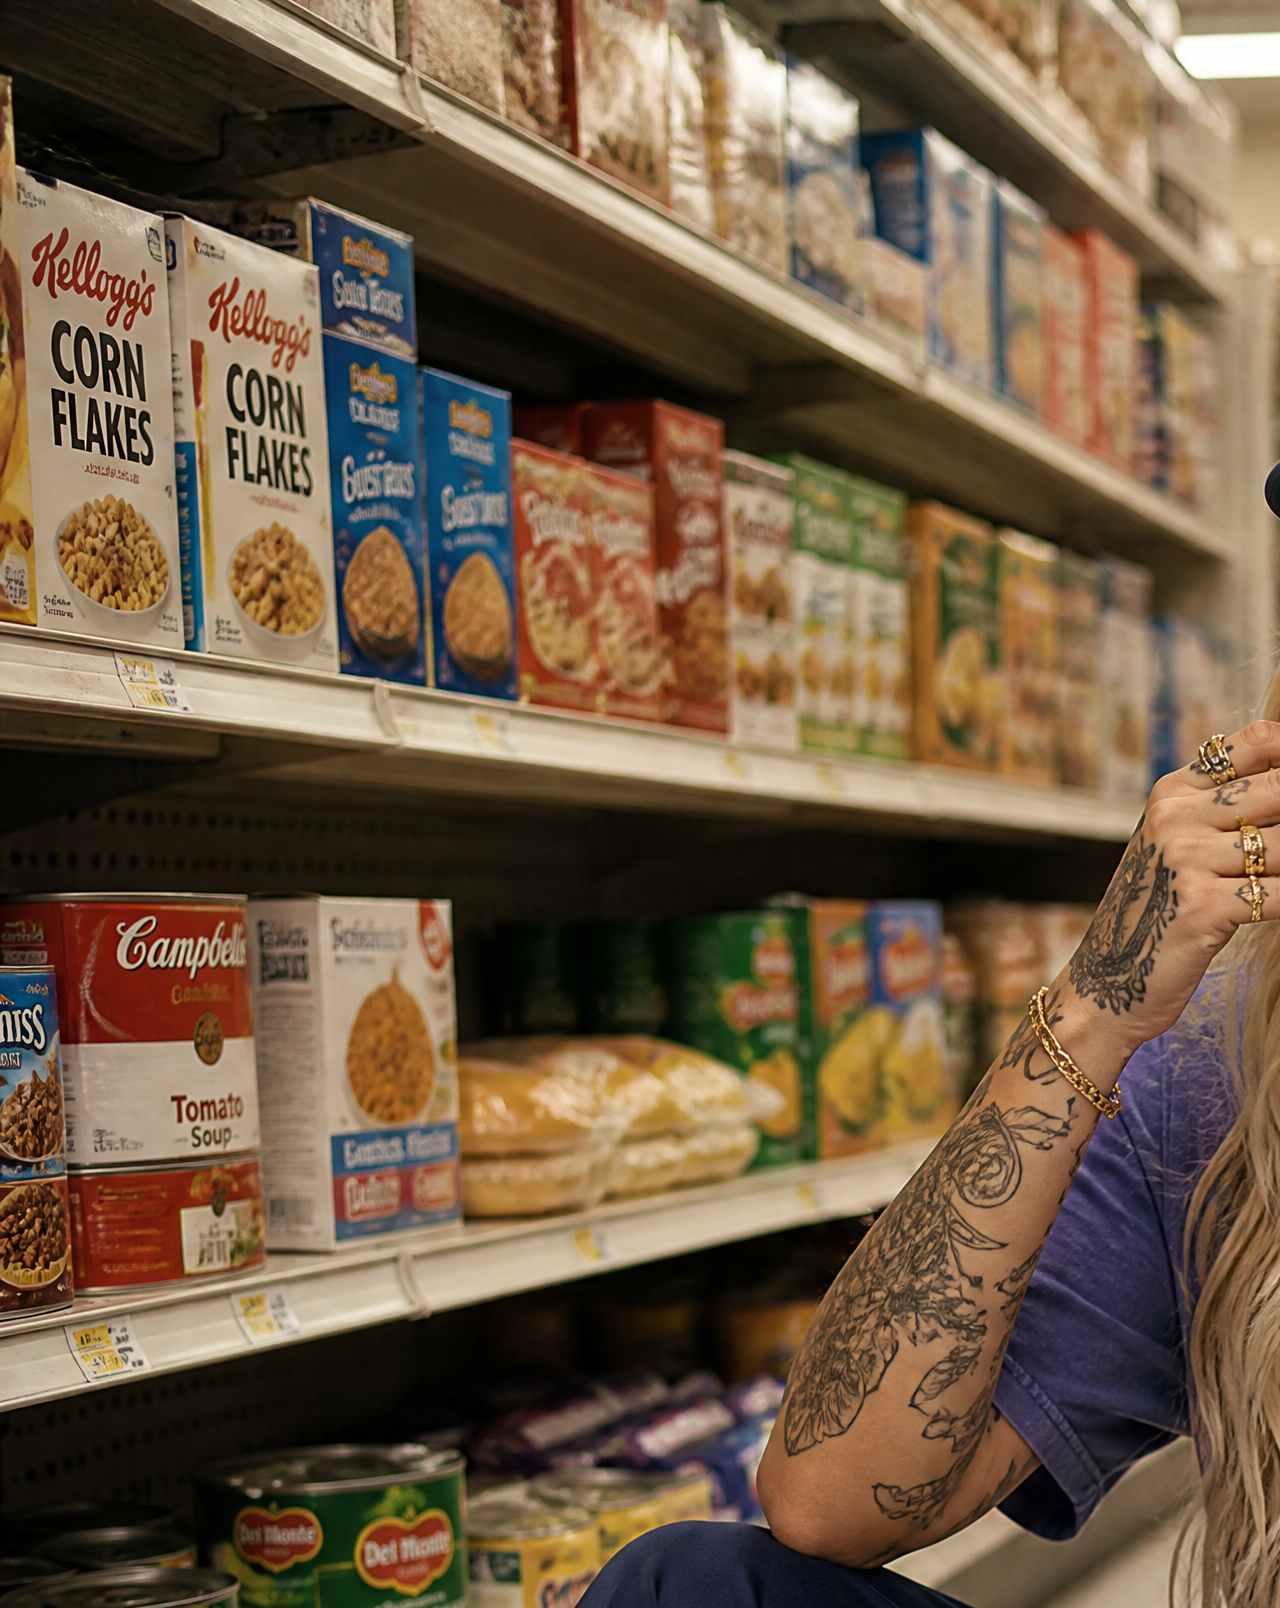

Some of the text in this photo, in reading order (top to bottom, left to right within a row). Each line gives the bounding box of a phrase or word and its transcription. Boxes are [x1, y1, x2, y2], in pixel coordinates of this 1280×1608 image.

[31, 226, 156, 331] Kellogg's
[51, 319, 147, 402] CORN
[208, 276, 312, 374] Kellogg's
[51, 387, 155, 467] FLAKES
[226, 363, 306, 438] CORN
[225, 426, 313, 497] FLAKES
[170, 1092, 245, 1124] Tomato
[190, 1125, 233, 1149] Soup
